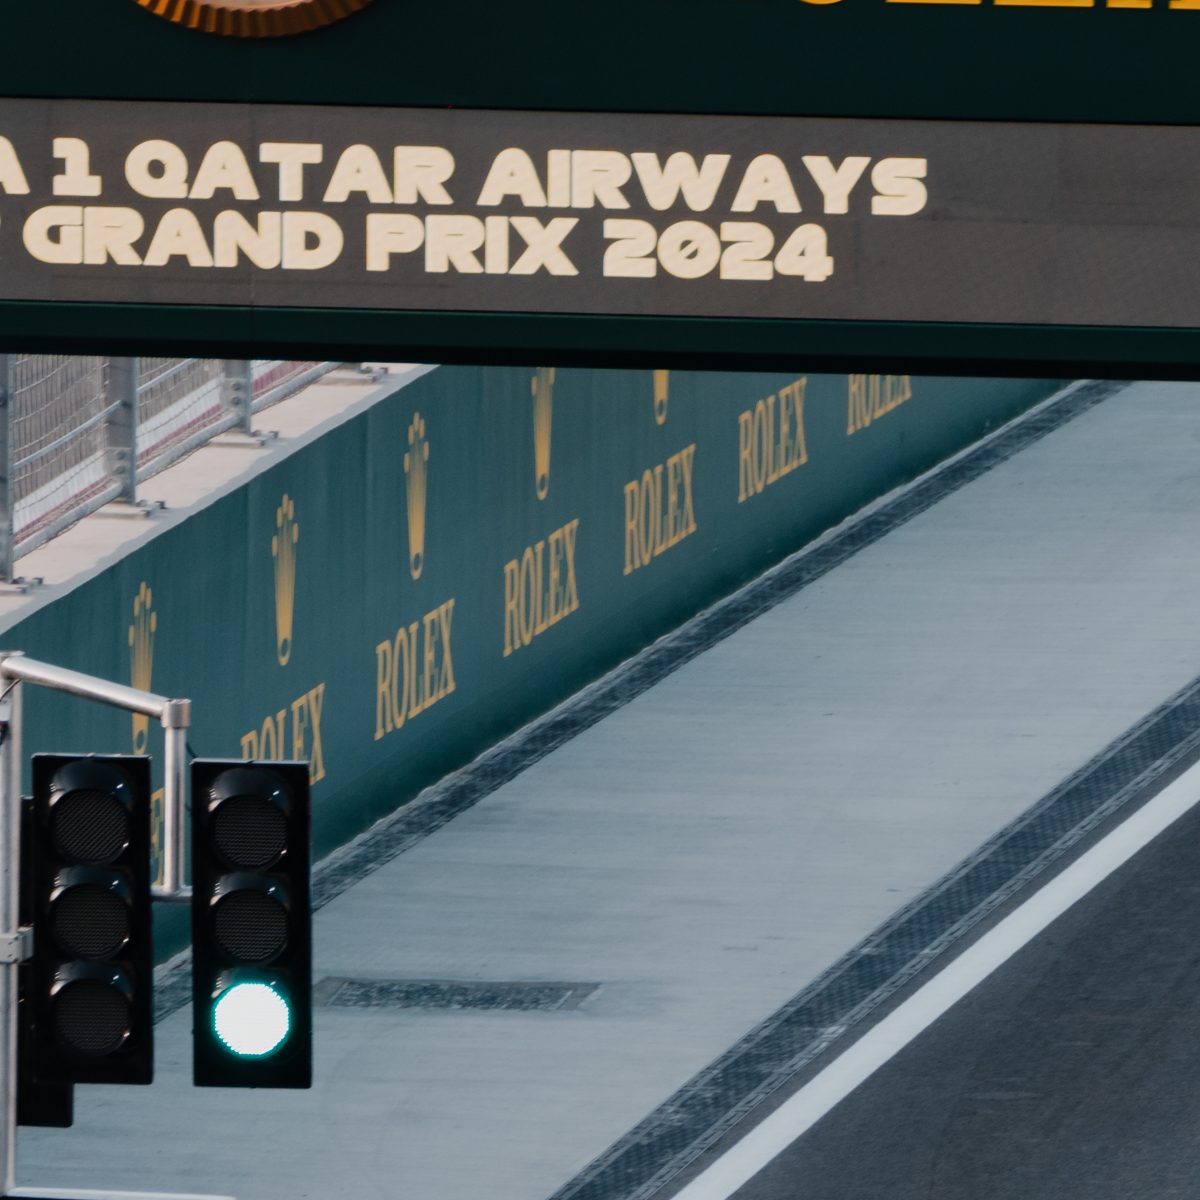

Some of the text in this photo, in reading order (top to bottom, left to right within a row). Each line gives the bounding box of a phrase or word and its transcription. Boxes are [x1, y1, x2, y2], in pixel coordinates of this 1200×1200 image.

[53, 138, 101, 196] 1
[125, 140, 455, 205] QATAR
[477, 148, 927, 215] AIRWAYS
[23, 206, 833, 281] GRAND PRIX 2024
[738, 377, 807, 502] ROLEX
[624, 443, 697, 575] ROLEX
[503, 519, 579, 656] ROLEX
[375, 599, 456, 740] ROLEX
